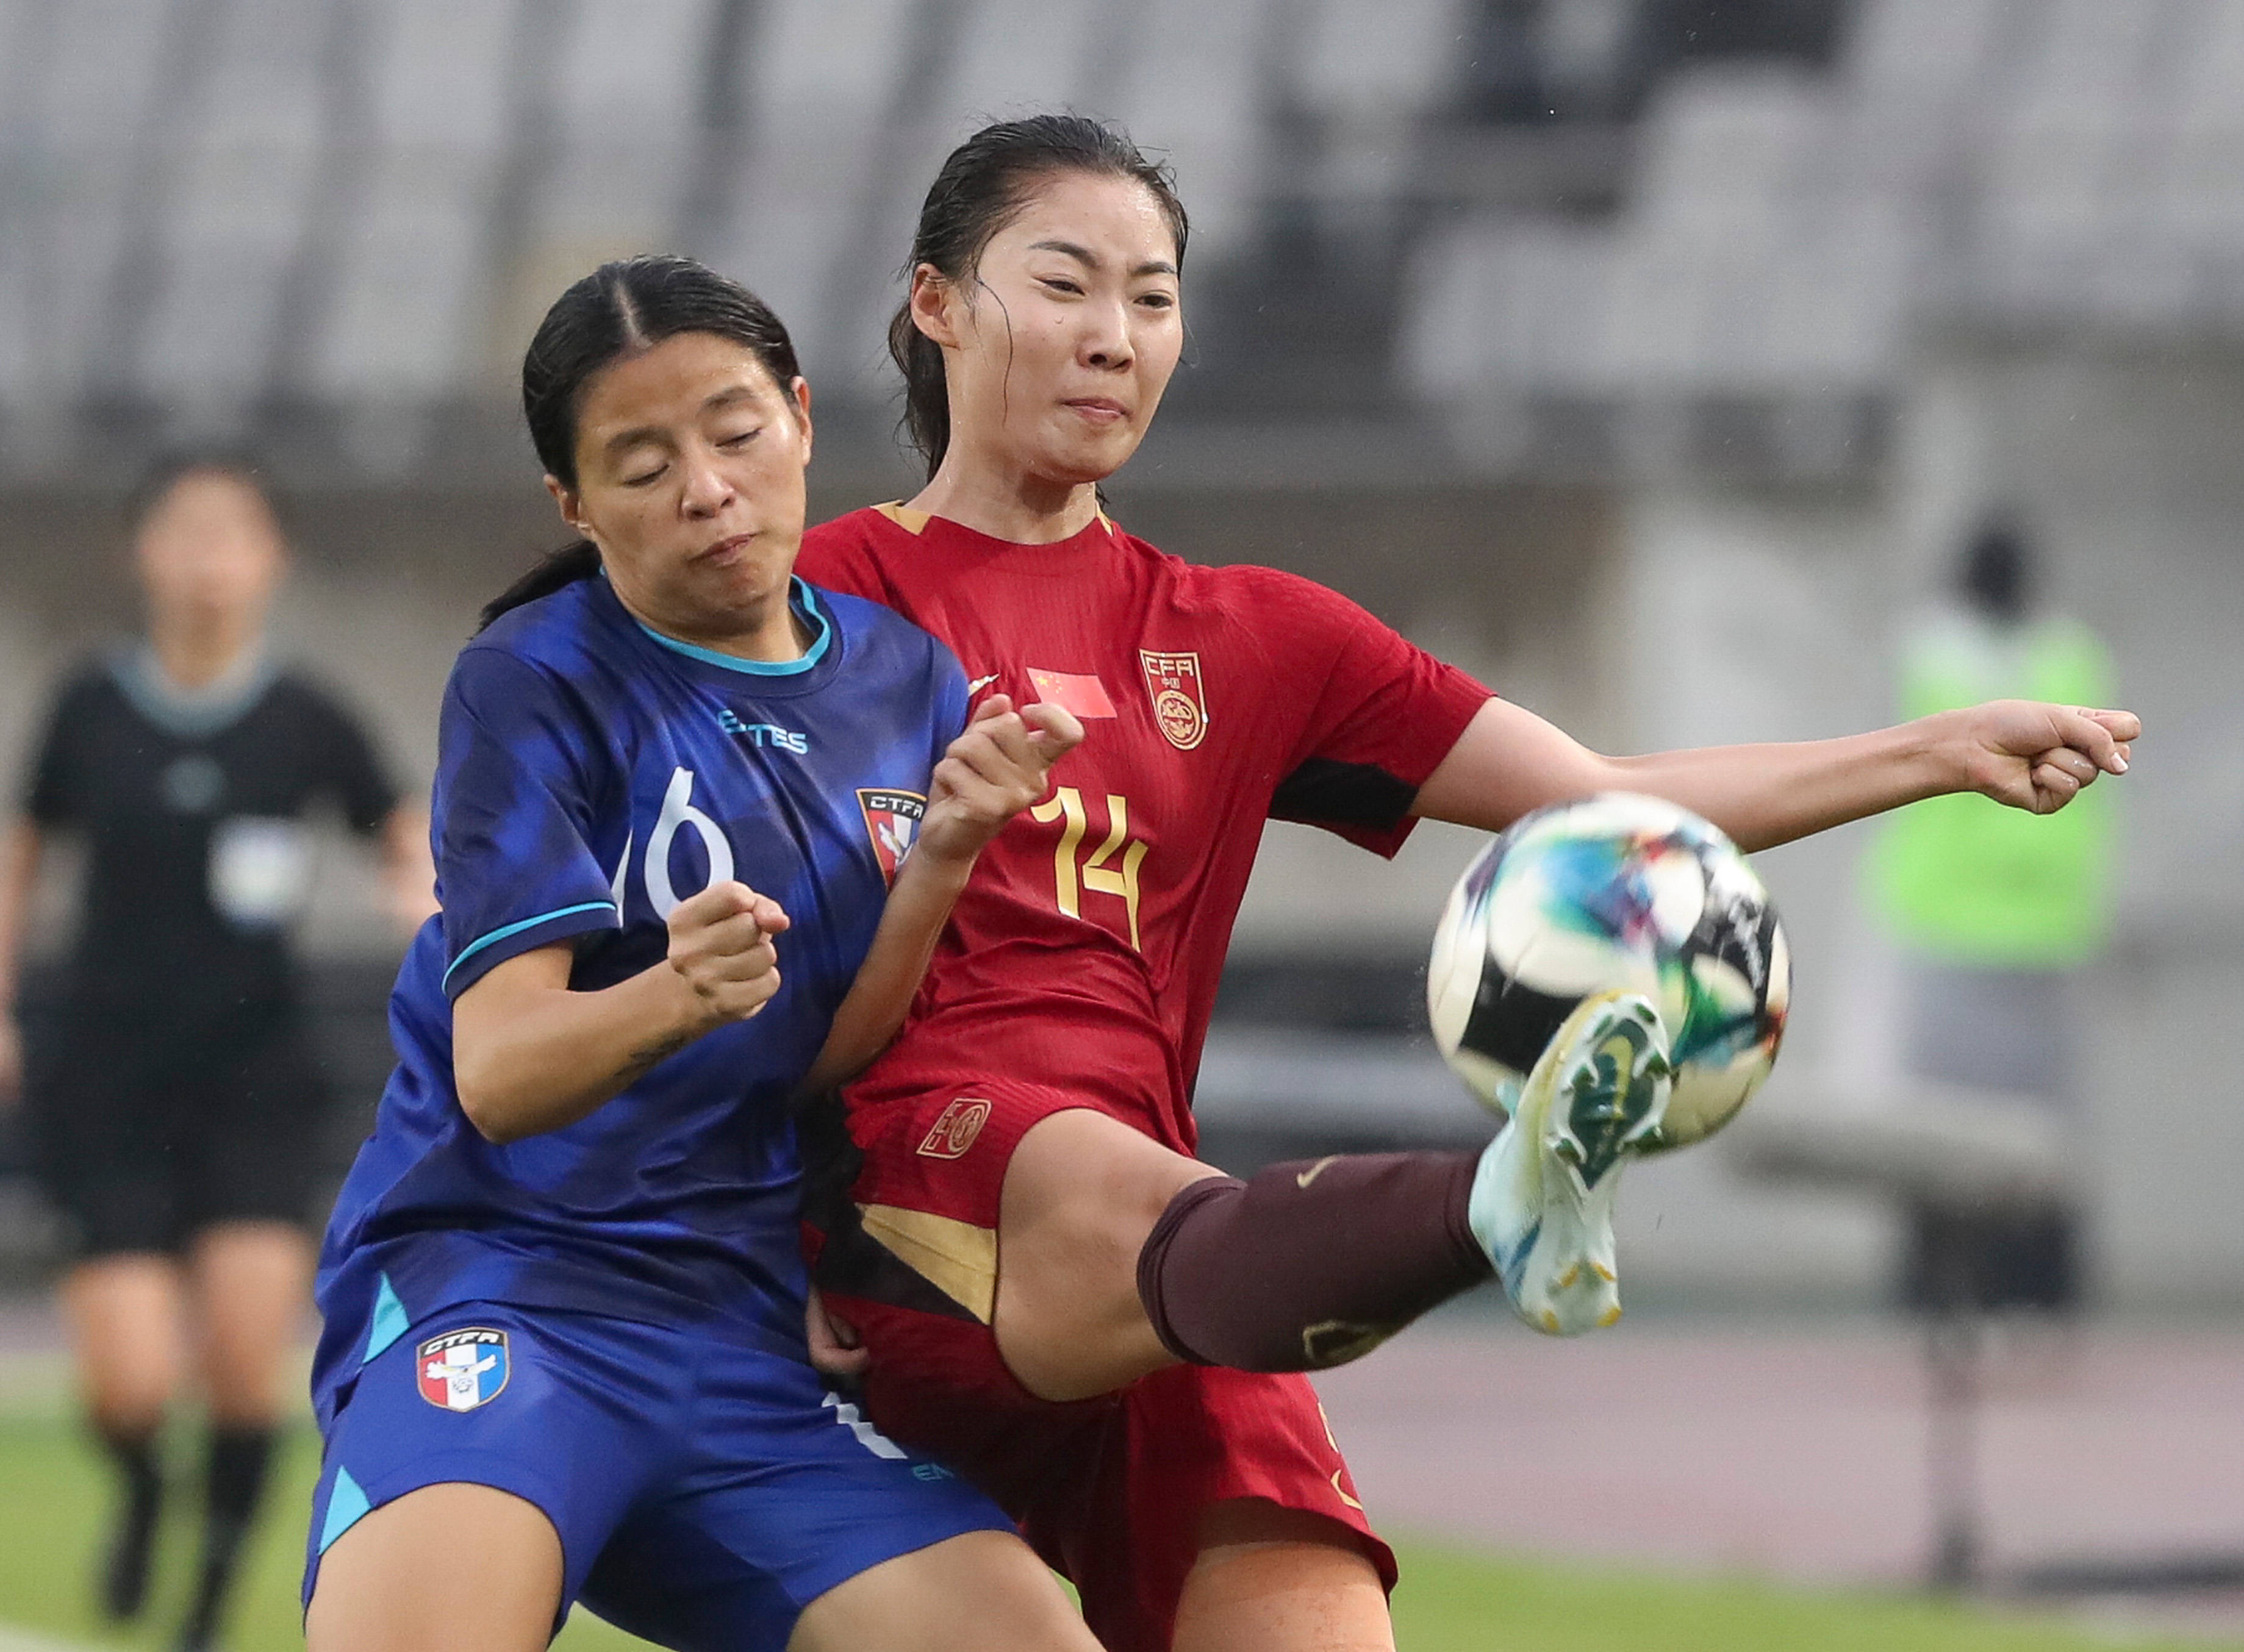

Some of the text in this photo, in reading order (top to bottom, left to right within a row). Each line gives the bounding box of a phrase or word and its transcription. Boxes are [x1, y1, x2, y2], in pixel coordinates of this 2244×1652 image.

[1145, 656, 1194, 677] CFA
[870, 796, 924, 819] CTFA
[1030, 786, 1149, 953] 14
[423, 1331, 500, 1356] CTFA
